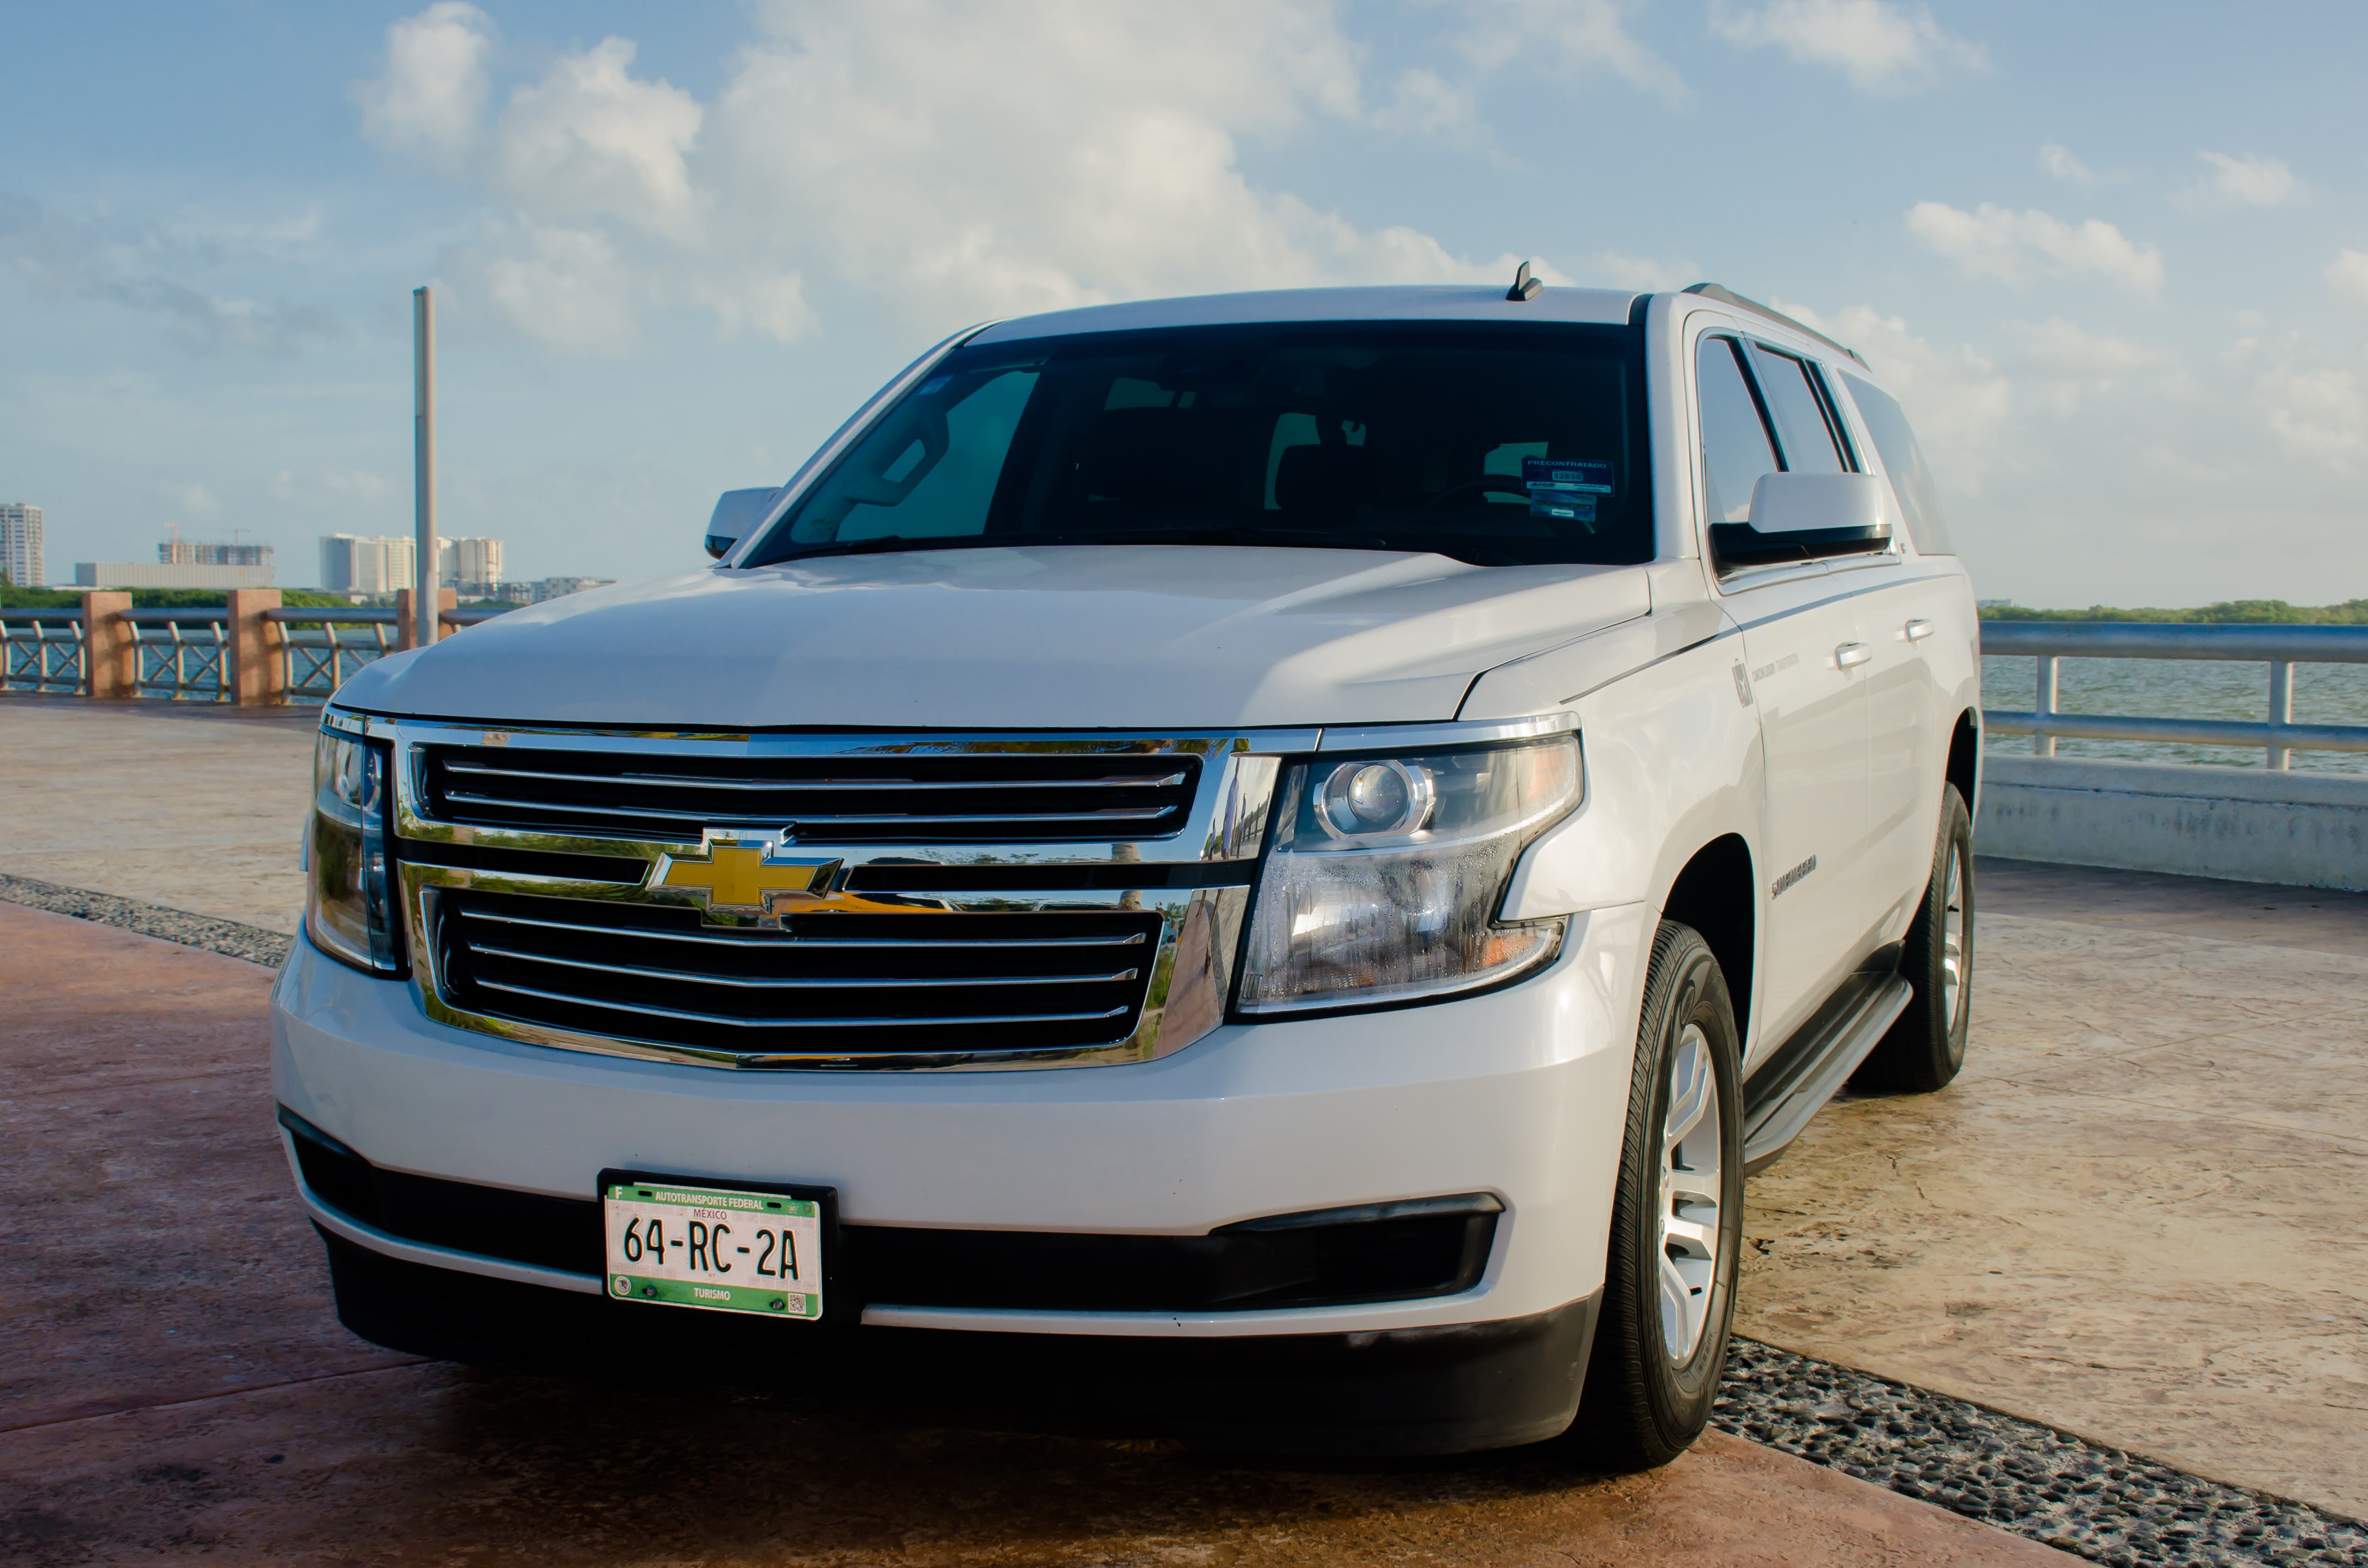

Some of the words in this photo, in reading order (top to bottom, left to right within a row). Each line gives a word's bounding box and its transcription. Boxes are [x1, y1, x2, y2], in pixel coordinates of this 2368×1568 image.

[1527, 460, 1607, 469] PRECONTRATADO
[615, 1186, 623, 1199] F
[655, 1191, 727, 1207] AUTOTRANSPORTE
[728, 1198, 763, 1210] FEDERAL
[694, 1207, 727, 1220] MÉXICO
[624, 1216, 799, 1280] 64-RC-2A
[694, 1287, 731, 1301] TURISMO
